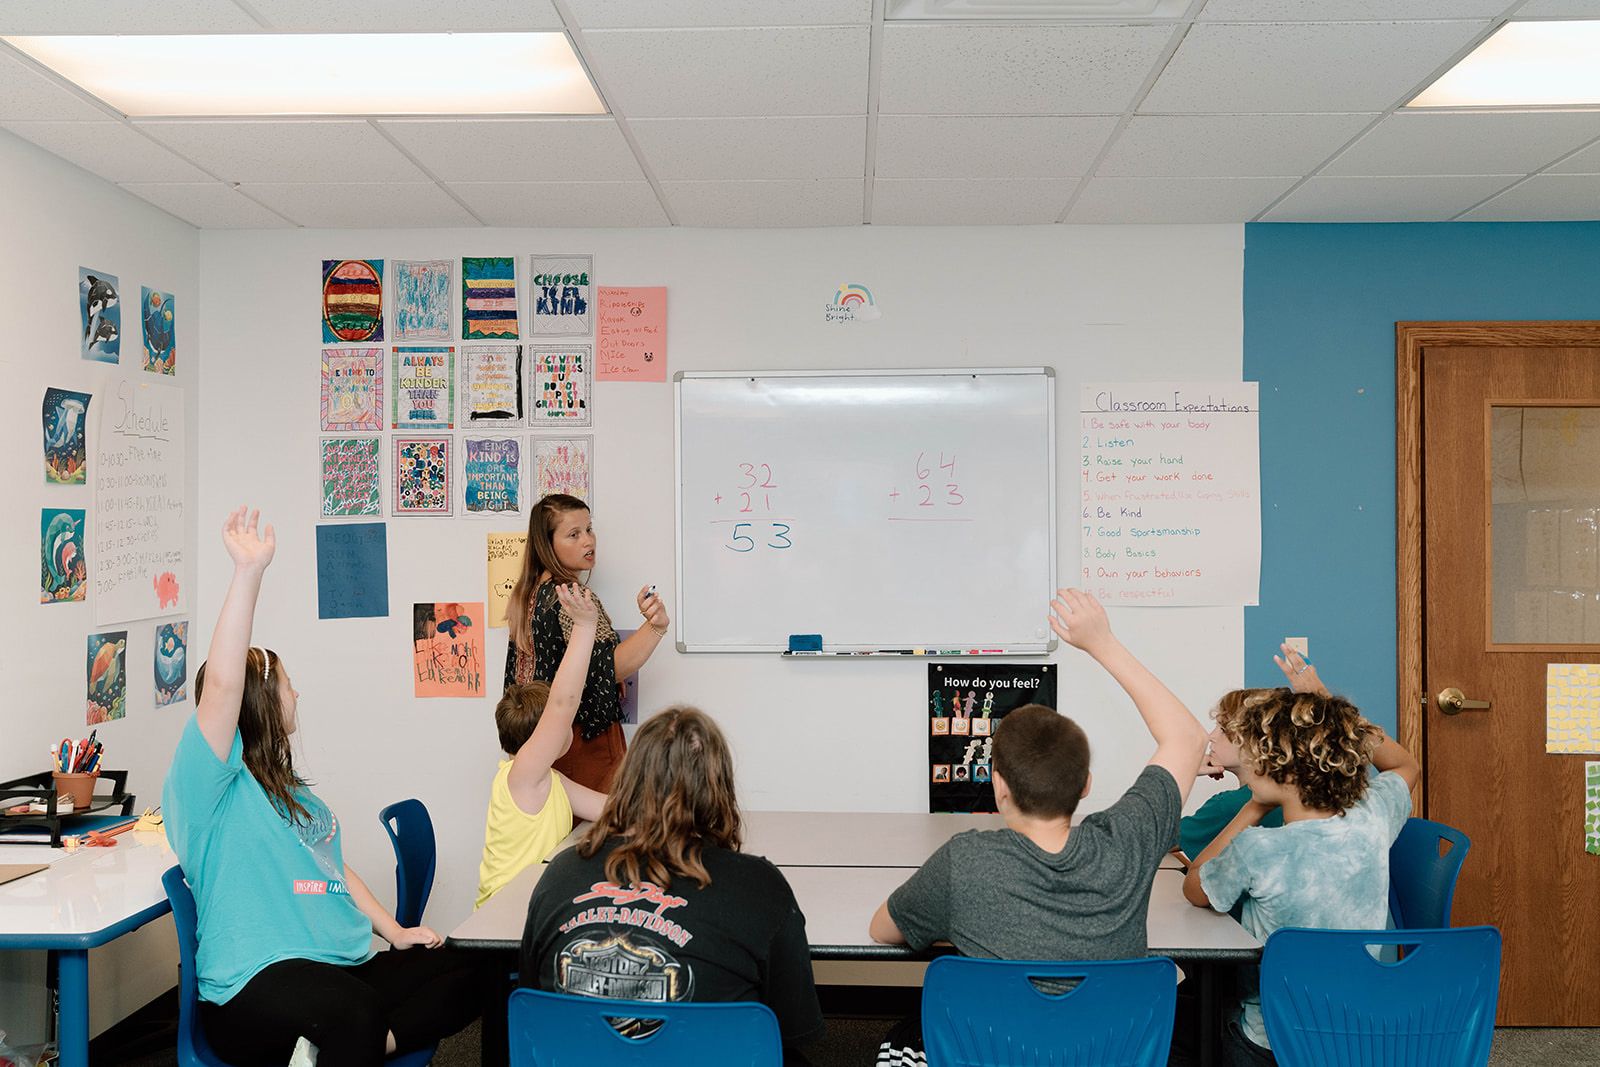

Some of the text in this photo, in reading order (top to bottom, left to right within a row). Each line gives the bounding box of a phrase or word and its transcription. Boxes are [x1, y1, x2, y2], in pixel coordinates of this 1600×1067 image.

[535, 272, 590, 286] CHOOSE
[826, 304, 850, 312] Shine
[826, 313, 855, 323] Bright
[403, 356, 445, 367] ALWAYS
[416, 367, 433, 378] BE
[400, 378, 448, 389] KINDER
[412, 400, 435, 410] YOU
[1096, 391, 1250, 414] Classroom Expectations
[1091, 417, 1104, 429] Be
[1109, 418, 1131, 429] safe
[1134, 418, 1155, 428] with
[1161, 420, 1181, 431] your
[1188, 418, 1211, 431] body
[1097, 436, 1135, 448] Listen
[469, 449, 517, 463] KIND IS
[1096, 454, 1123, 466] Raise
[1131, 457, 1152, 468] your
[1159, 453, 1184, 465] hand
[916, 452, 955, 479] 64
[468, 472, 518, 482] IMPORTANT
[737, 463, 776, 489] 32
[1095, 470, 1117, 482] Get
[1126, 474, 1146, 484] your
[1154, 471, 1181, 482] work
[1191, 472, 1214, 481] done
[480, 481, 505, 491] THAN
[477, 490, 509, 501] BEING
[919, 484, 964, 505] 23
[740, 492, 771, 512] 21
[1096, 505, 1112, 518] Be
[1120, 505, 1142, 518] Kind
[725, 523, 792, 552] 53
[1097, 525, 1122, 538] Good
[1130, 526, 1201, 539] Sportsmanship
[1095, 546, 1117, 559] Body
[1125, 546, 1157, 558] Basics
[1096, 566, 1120, 578] Own
[1126, 568, 1149, 580] your
[1154, 565, 1202, 578] behaviors
[1097, 587, 1112, 599] Be
[1118, 587, 1175, 600] respectful
[944, 676, 1040, 690] How do you feel?
[559, 906, 693, 948] HARLEY-DAVIDSON
